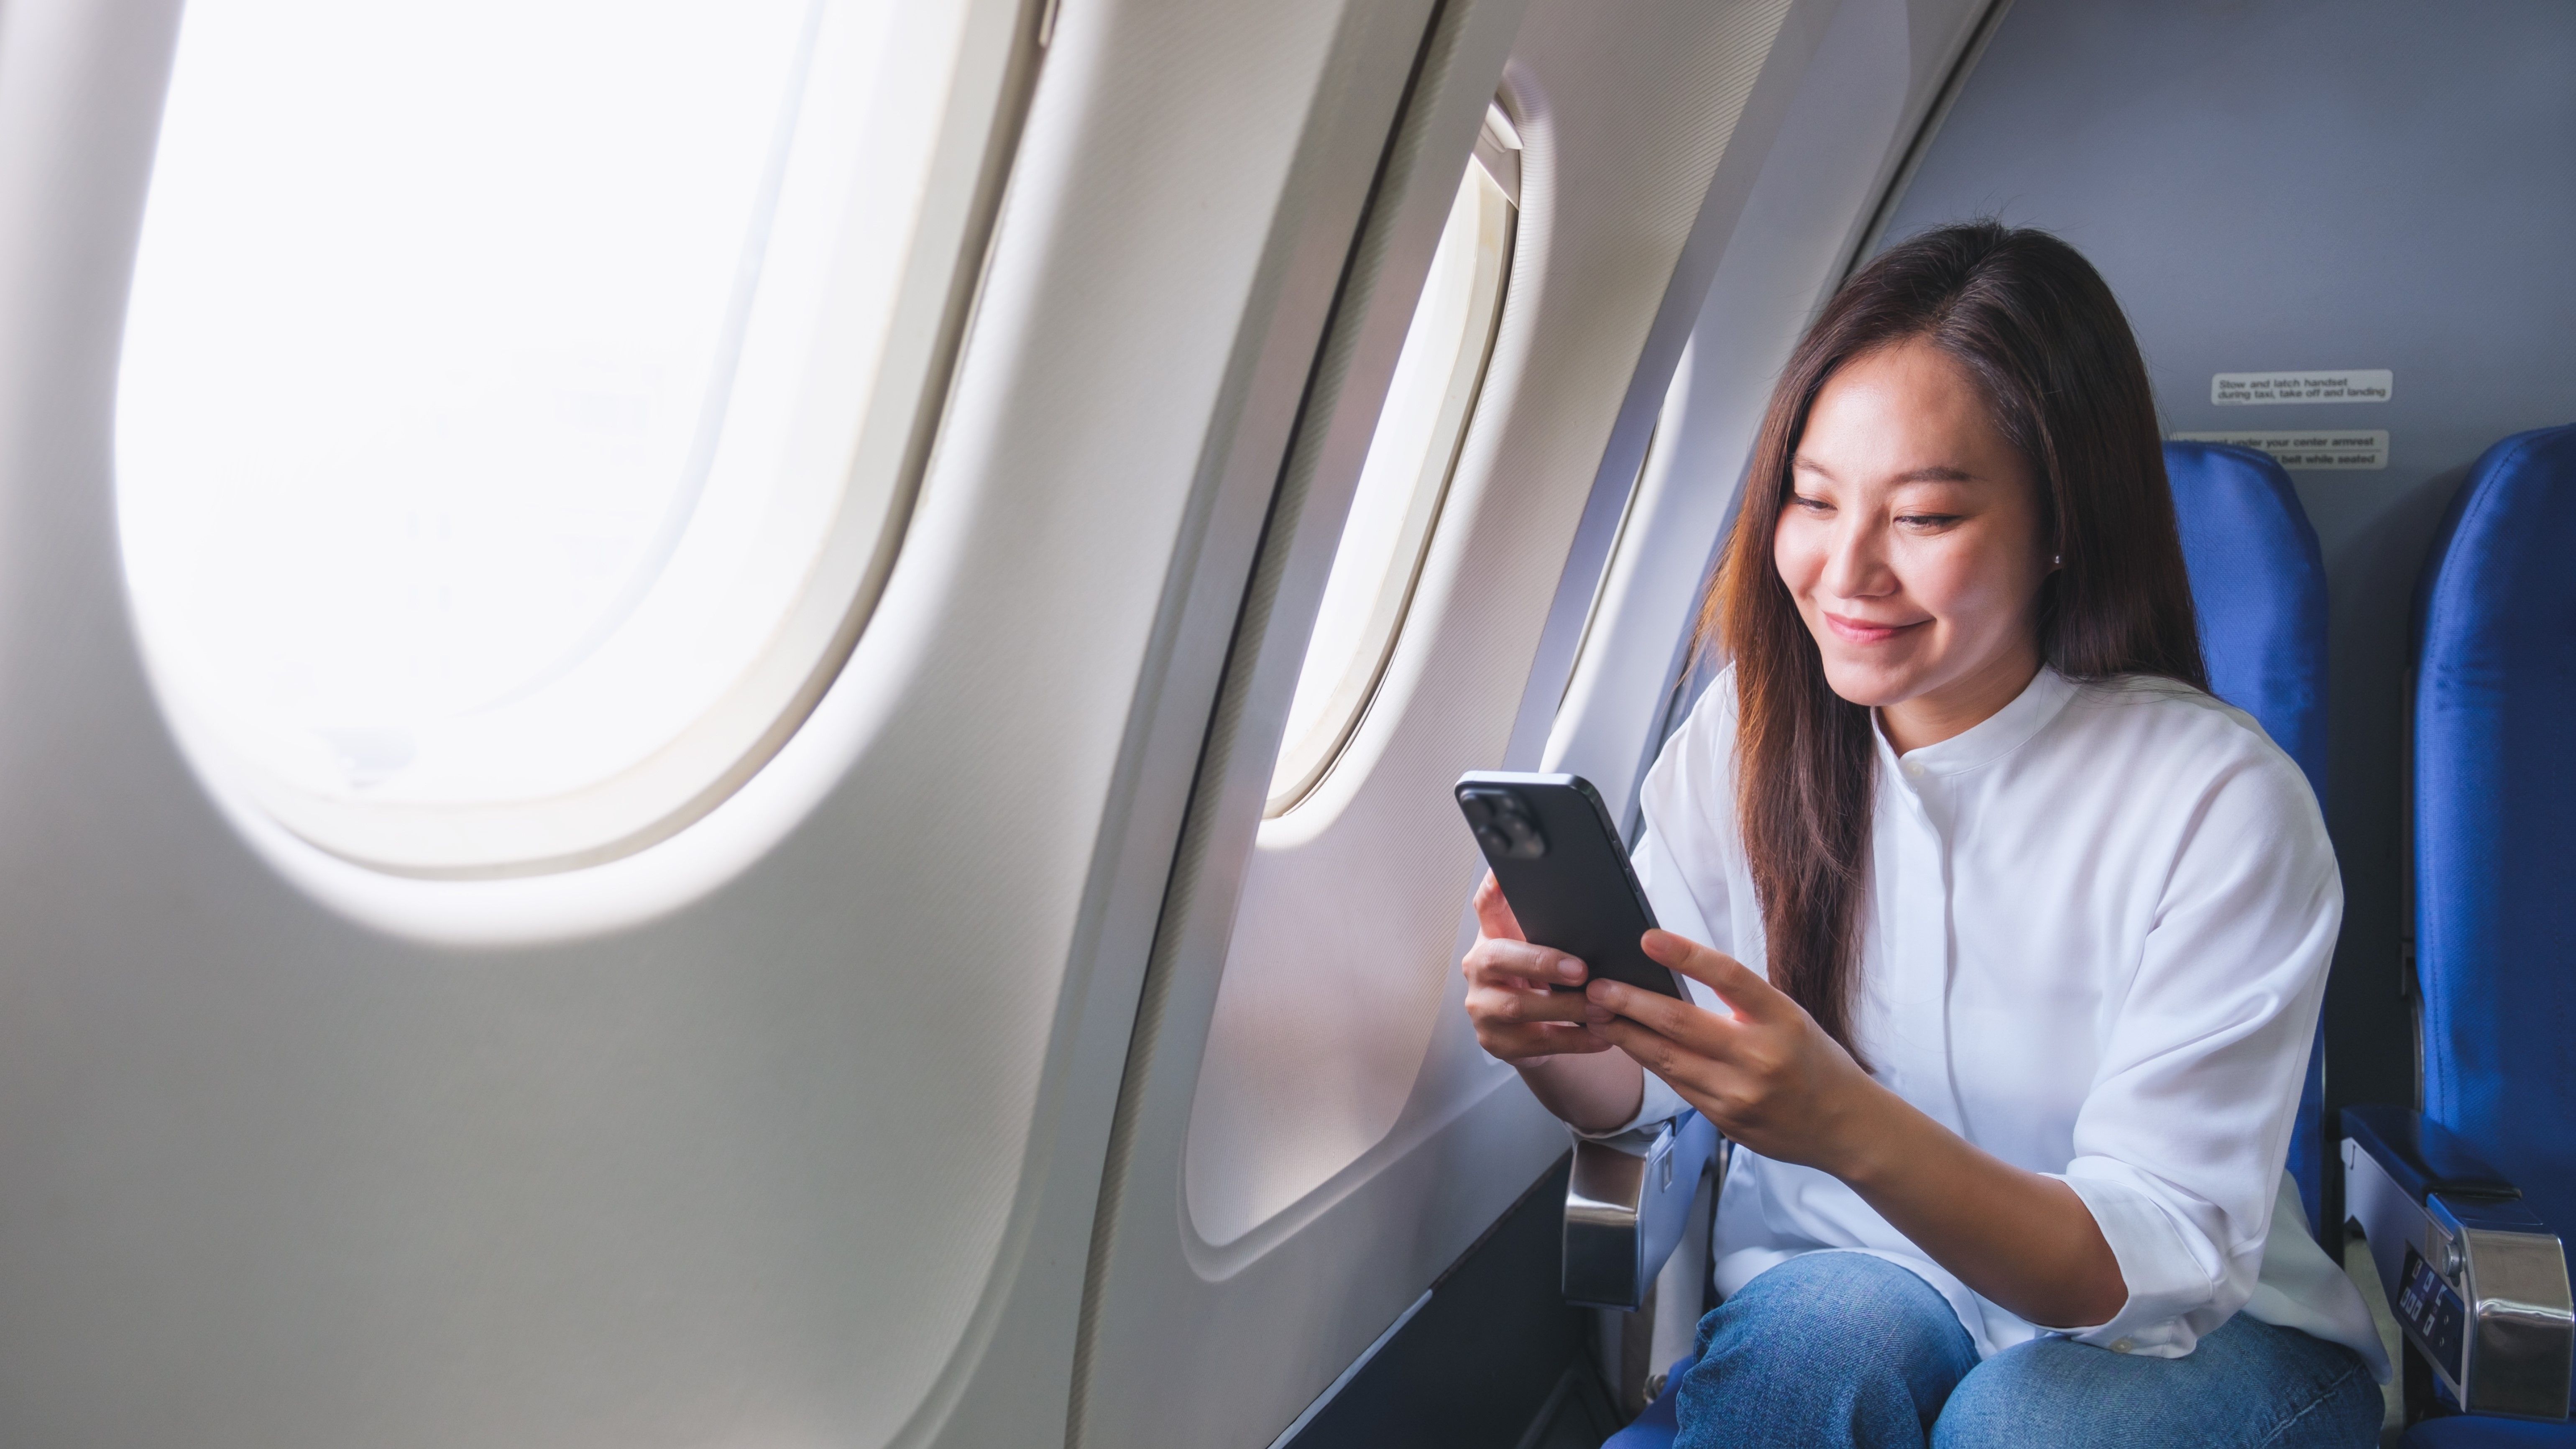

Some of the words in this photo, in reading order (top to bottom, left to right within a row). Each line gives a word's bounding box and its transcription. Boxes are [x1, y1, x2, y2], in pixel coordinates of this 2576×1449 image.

[2220, 380, 2245, 388] Stow
[2250, 380, 2270, 388] and
[2274, 379, 2300, 388] latch
[2305, 378, 2348, 387] handset
[2218, 391, 2251, 400] during
[2254, 391, 2275, 399] taxi,
[2280, 390, 2302, 399] take
[2323, 389, 2343, 397] and
[2348, 388, 2386, 398] landing
[2266, 439, 2289, 448] your
[2293, 438, 2328, 447] center
[2332, 437, 2374, 446] armrest
[2282, 455, 2301, 463] belt
[2306, 455, 2333, 463] while
[2338, 455, 2375, 463] seated
